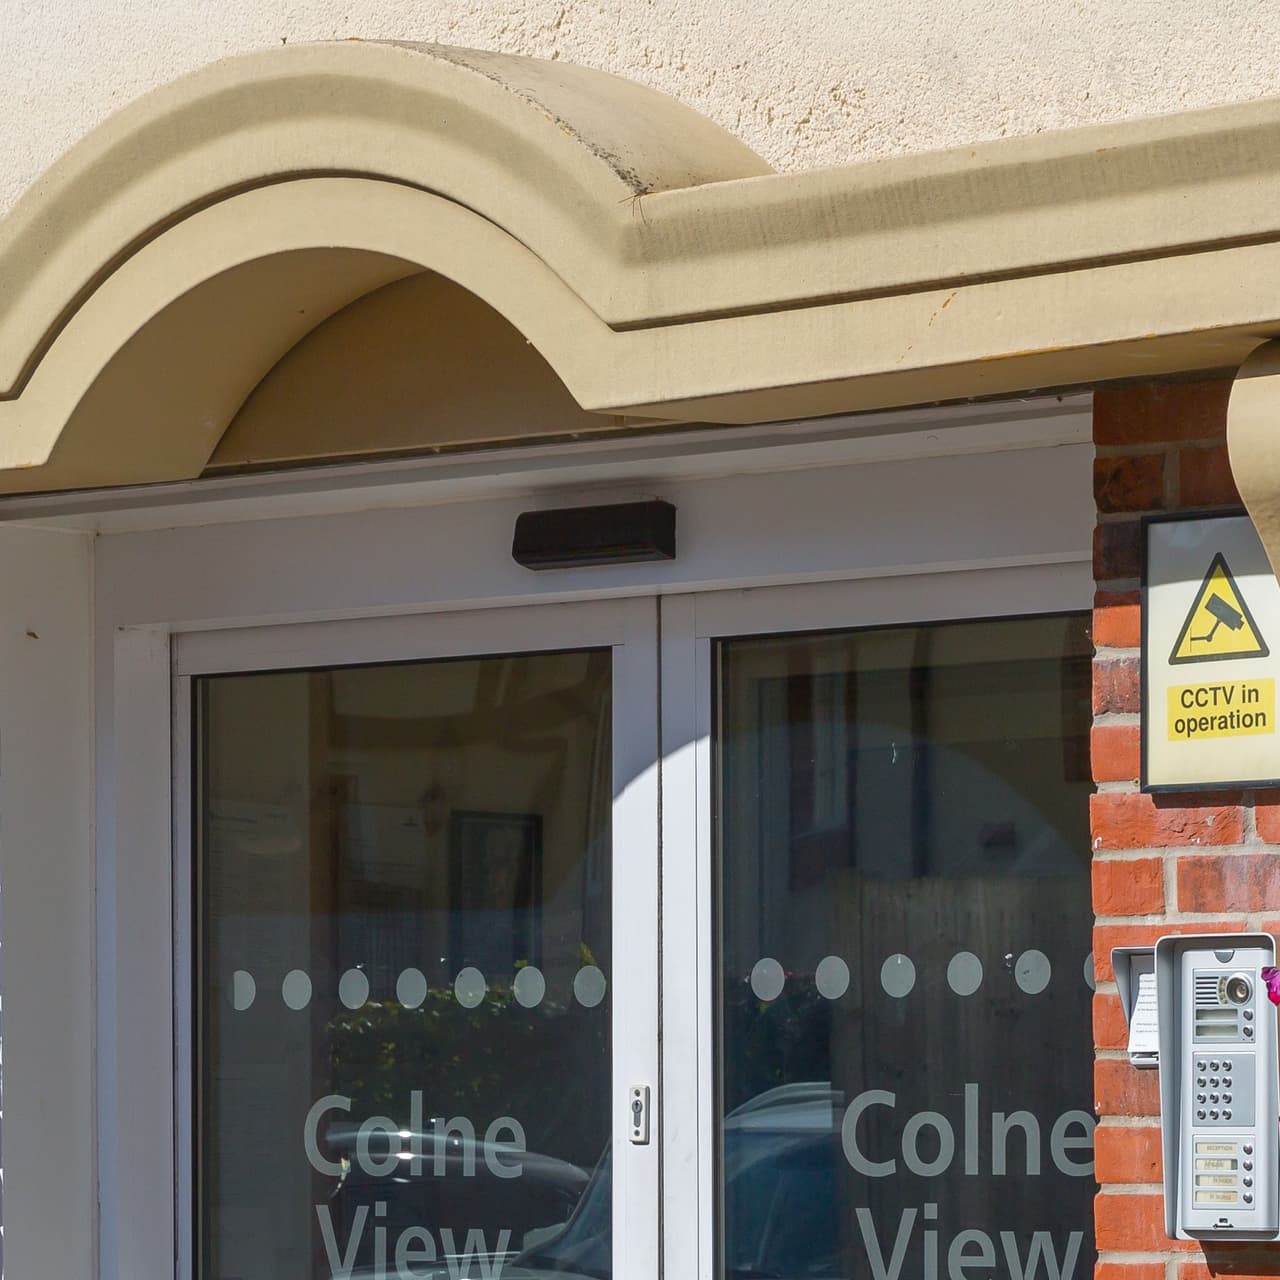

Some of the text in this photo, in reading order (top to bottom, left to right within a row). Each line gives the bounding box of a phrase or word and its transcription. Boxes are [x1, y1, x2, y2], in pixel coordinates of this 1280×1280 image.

[1174, 709, 1266, 737] operation
[1181, 684, 1259, 708] CCTV in
[303, 1090, 527, 1178] Colne
[842, 1083, 1094, 1177] Colne
